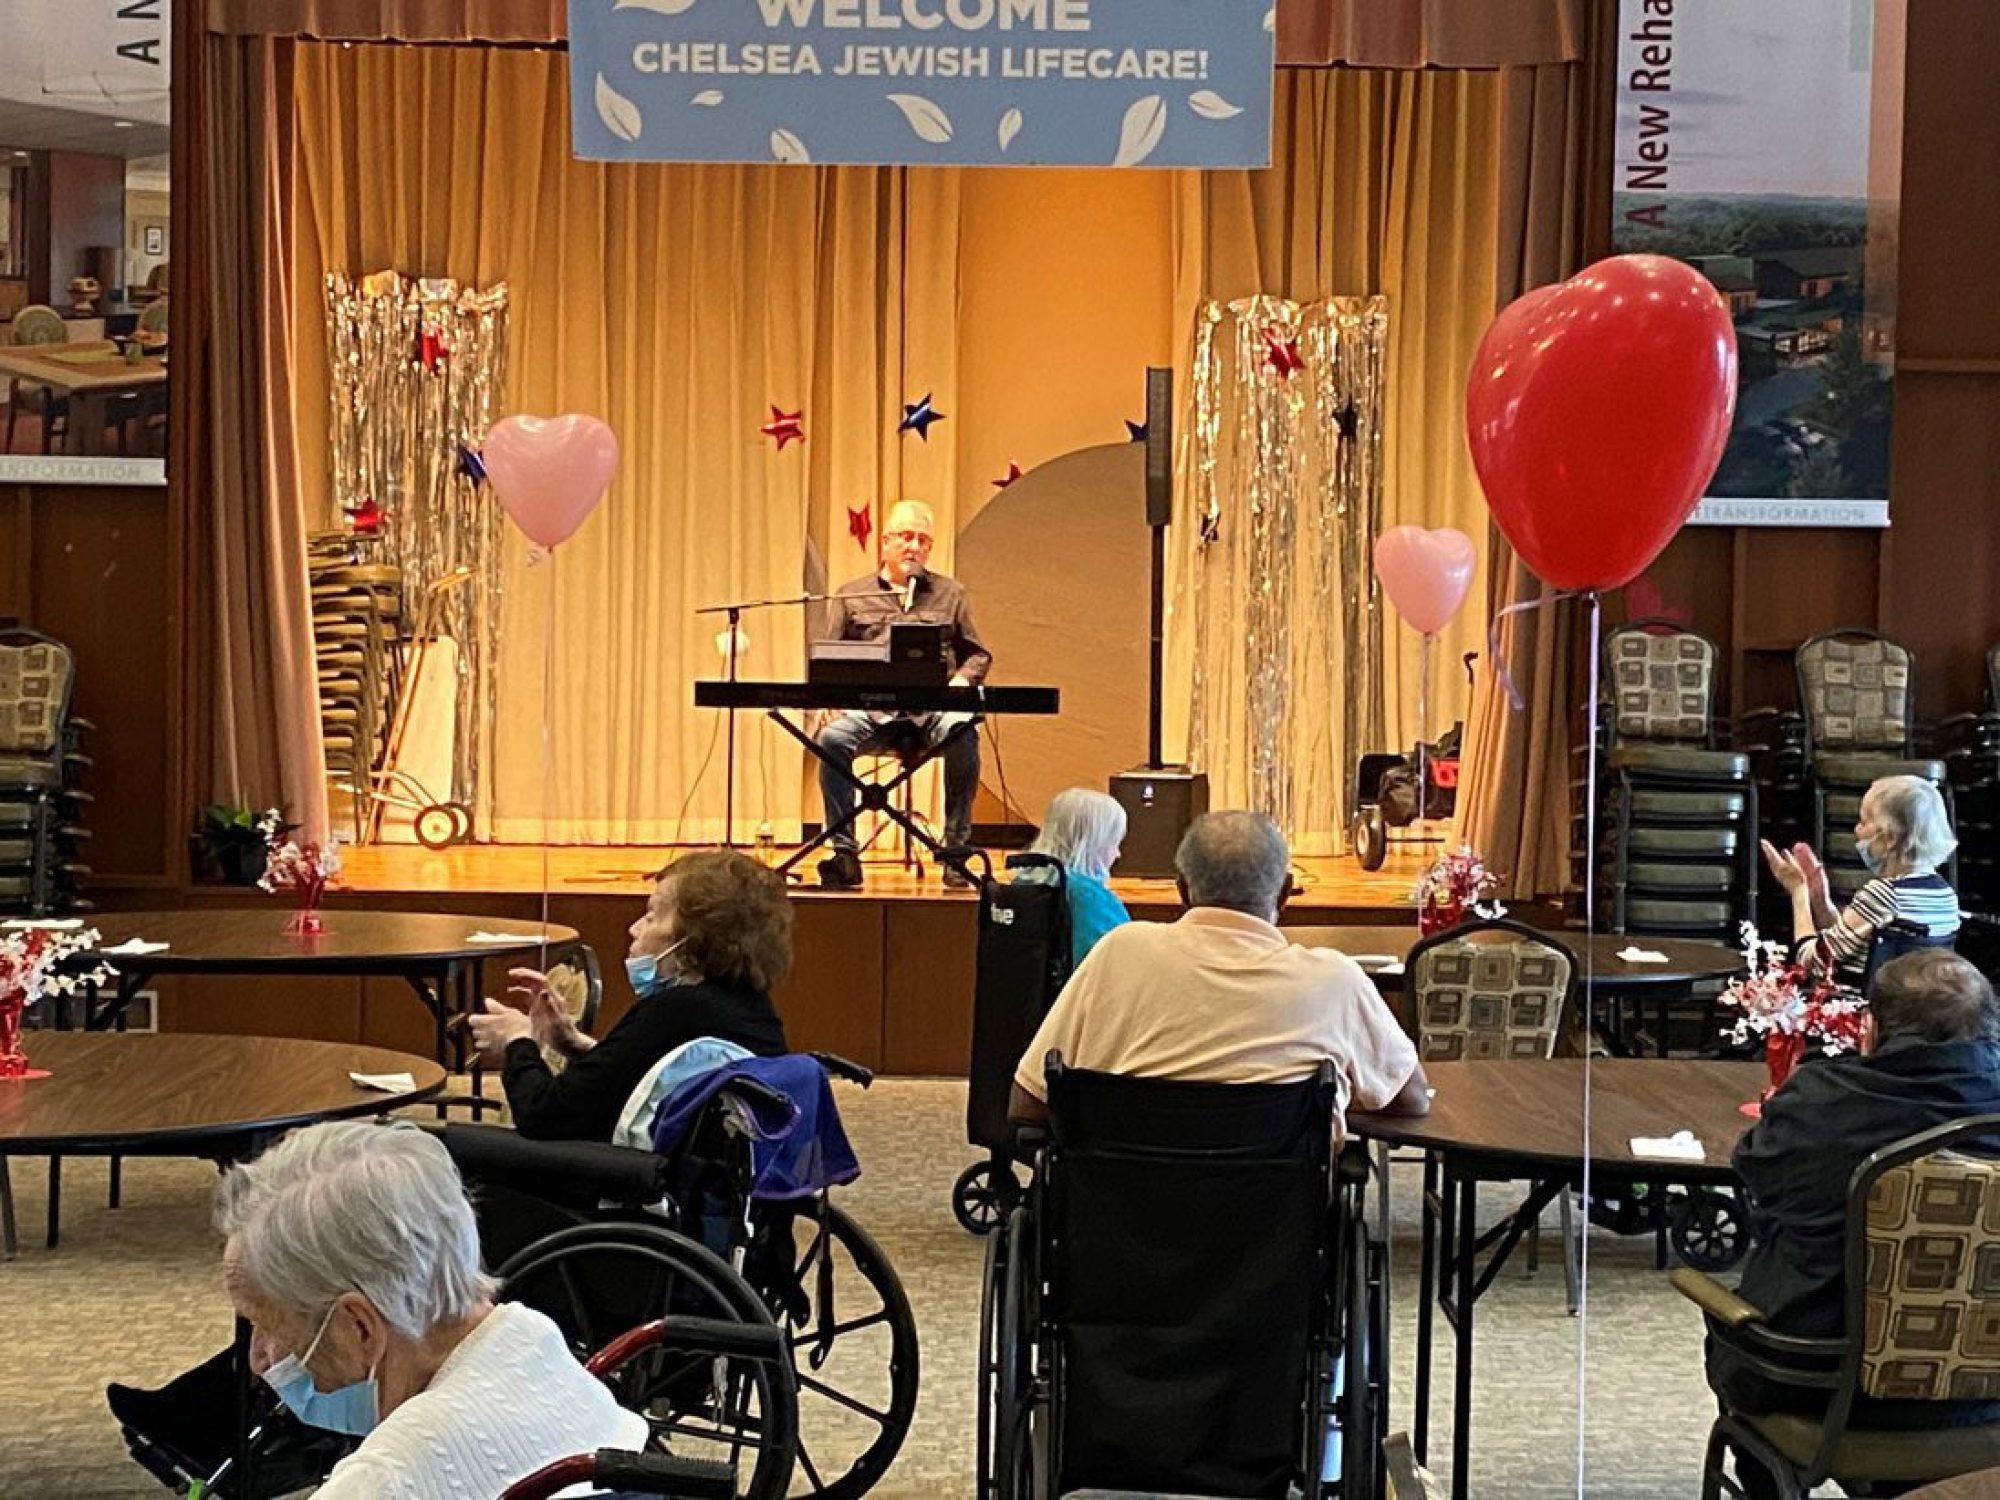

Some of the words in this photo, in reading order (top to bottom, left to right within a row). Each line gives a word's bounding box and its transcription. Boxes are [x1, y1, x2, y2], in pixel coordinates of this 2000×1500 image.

[755, 0, 1092, 31] WELCOME
[117, 39, 160, 65] A
[632, 42, 822, 75] CHELSEA
[833, 46, 989, 77] JEWISH
[1002, 48, 1209, 79] LIFECARE!
[1626, 104, 1670, 189] New
[1624, 203, 1667, 229] A
